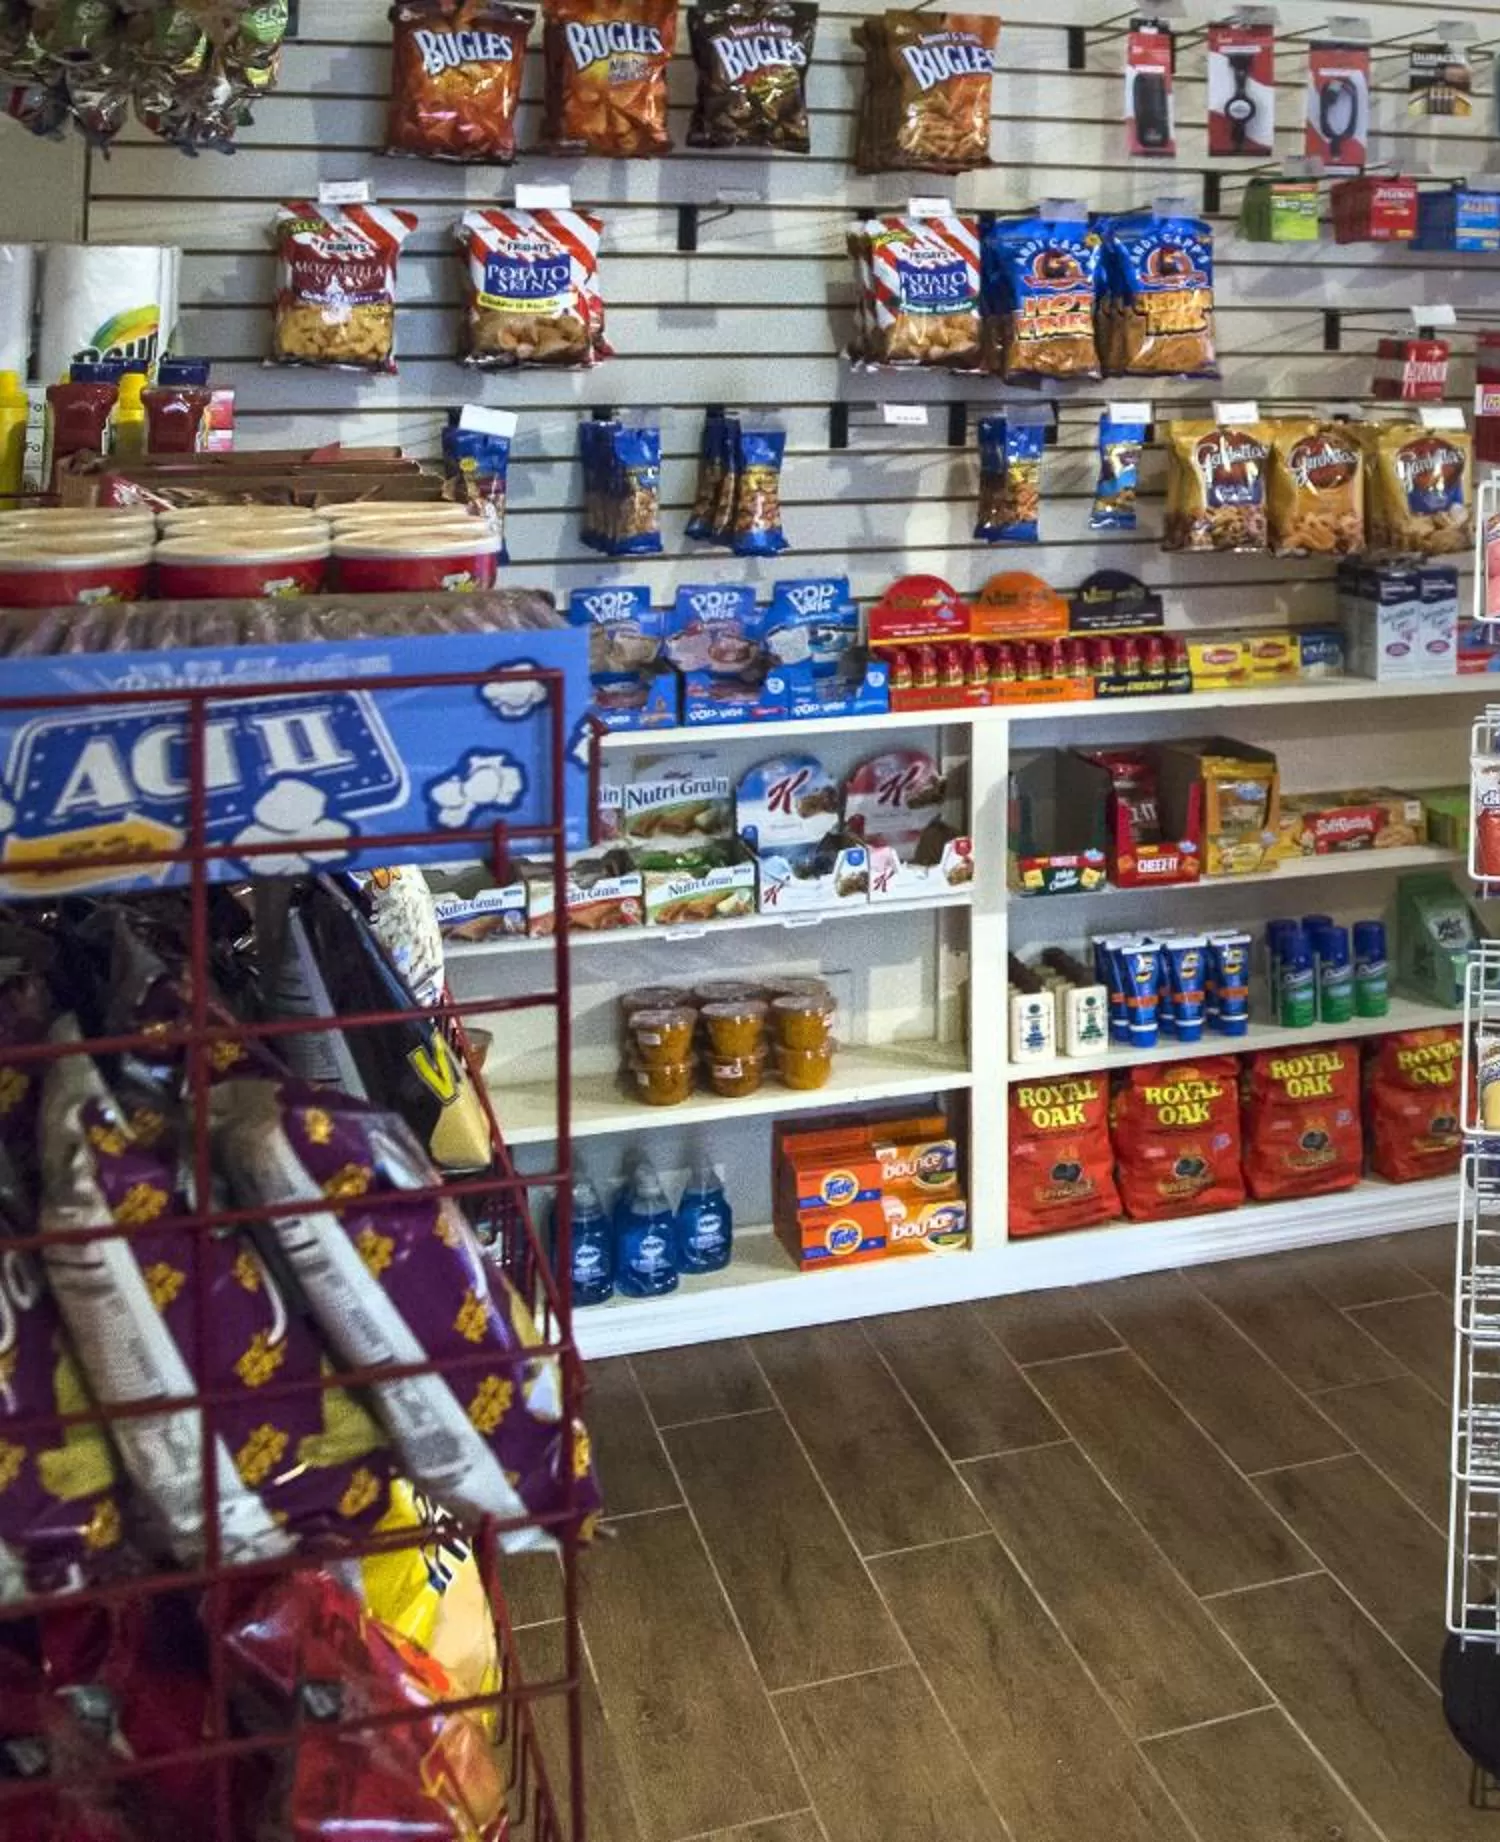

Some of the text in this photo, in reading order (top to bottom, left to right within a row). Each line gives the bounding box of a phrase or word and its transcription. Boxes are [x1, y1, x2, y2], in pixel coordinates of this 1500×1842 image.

[413, 28, 514, 76] BUGLES
[566, 21, 664, 71] BUGLES
[712, 35, 808, 82] BUGLES
[902, 44, 995, 91] BUGLES
[292, 260, 386, 279] MOZZARELLA
[486, 263, 570, 282] POTATO
[900, 271, 967, 287] POTATO
[497, 278, 558, 294] SKINS
[909, 285, 959, 298] SKINS
[50, 707, 355, 817] ACT II
[1270, 1050, 1345, 1081] ROYAL
[1017, 1078, 1099, 1109] ROYAL
[1144, 1079, 1224, 1107] ROYAL
[1286, 1073, 1334, 1099] OAK
[1030, 1102, 1087, 1129] OAK
[1157, 1101, 1212, 1126] OAK
[823, 1175, 858, 1200] Tide
[828, 1224, 860, 1248] Tide
